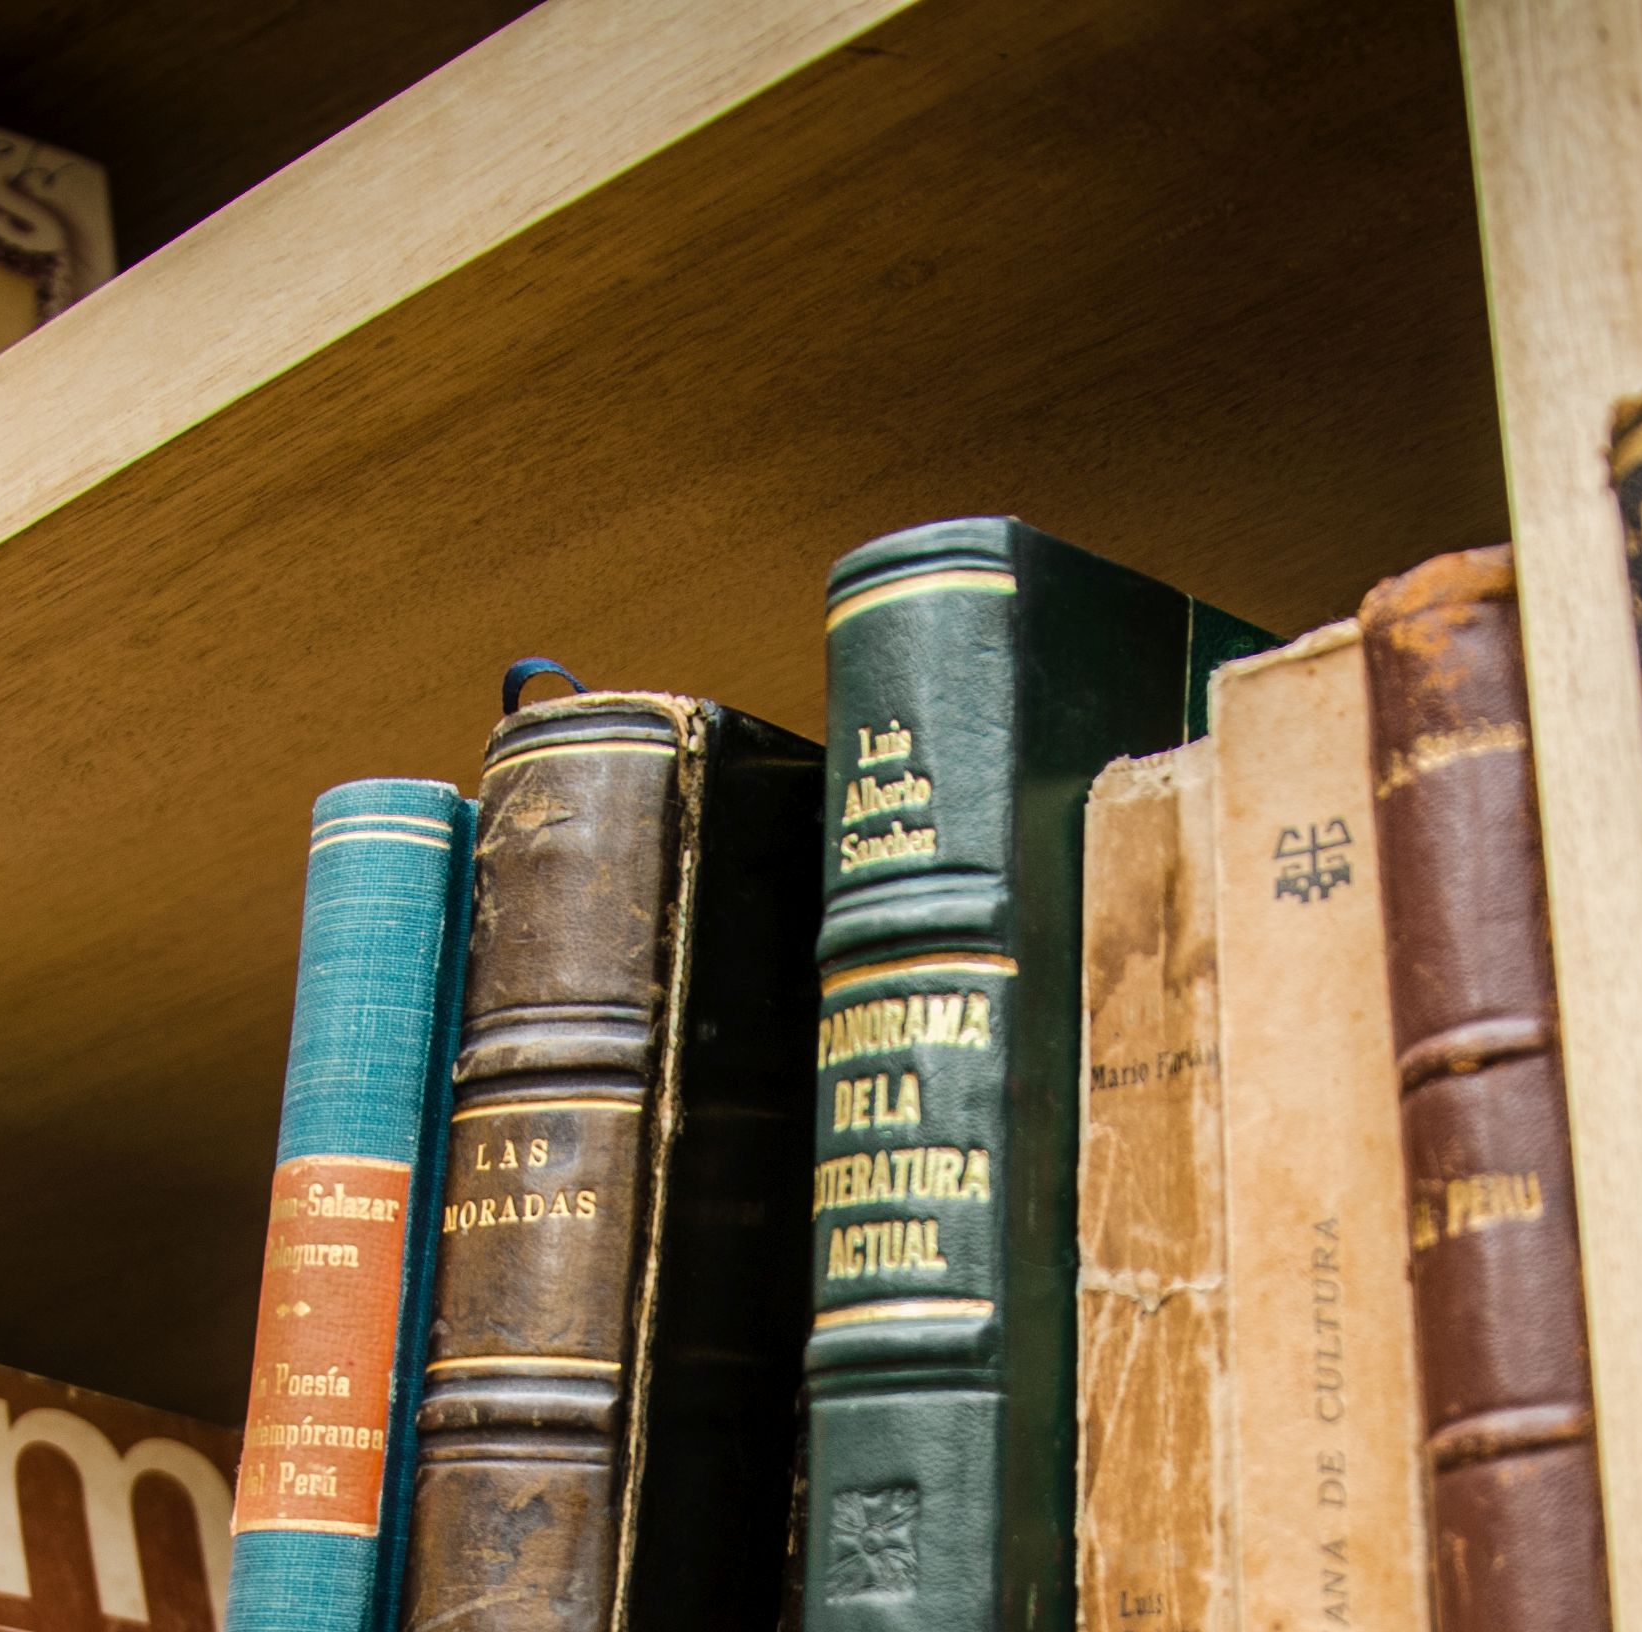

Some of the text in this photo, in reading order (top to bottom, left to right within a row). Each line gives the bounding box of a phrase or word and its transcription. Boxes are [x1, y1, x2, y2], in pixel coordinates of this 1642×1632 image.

[857, 720, 913, 768] Luis
[841, 772, 933, 826] Alberto
[817, 992, 991, 1071] PANORAMA
[1090, 1058, 1149, 1093] Mario
[833, 1071, 922, 1133] DE LA
[475, 1137, 551, 1172] LAS
[442, 1189, 598, 1235] MORADAS
[826, 1219, 948, 1281] ACTUAL
[1313, 1216, 1345, 1422] CULTURA
[274, 1363, 351, 1399] Poesía
[278, 1460, 338, 1498] Perú
[1321, 1450, 1345, 1510] DE
